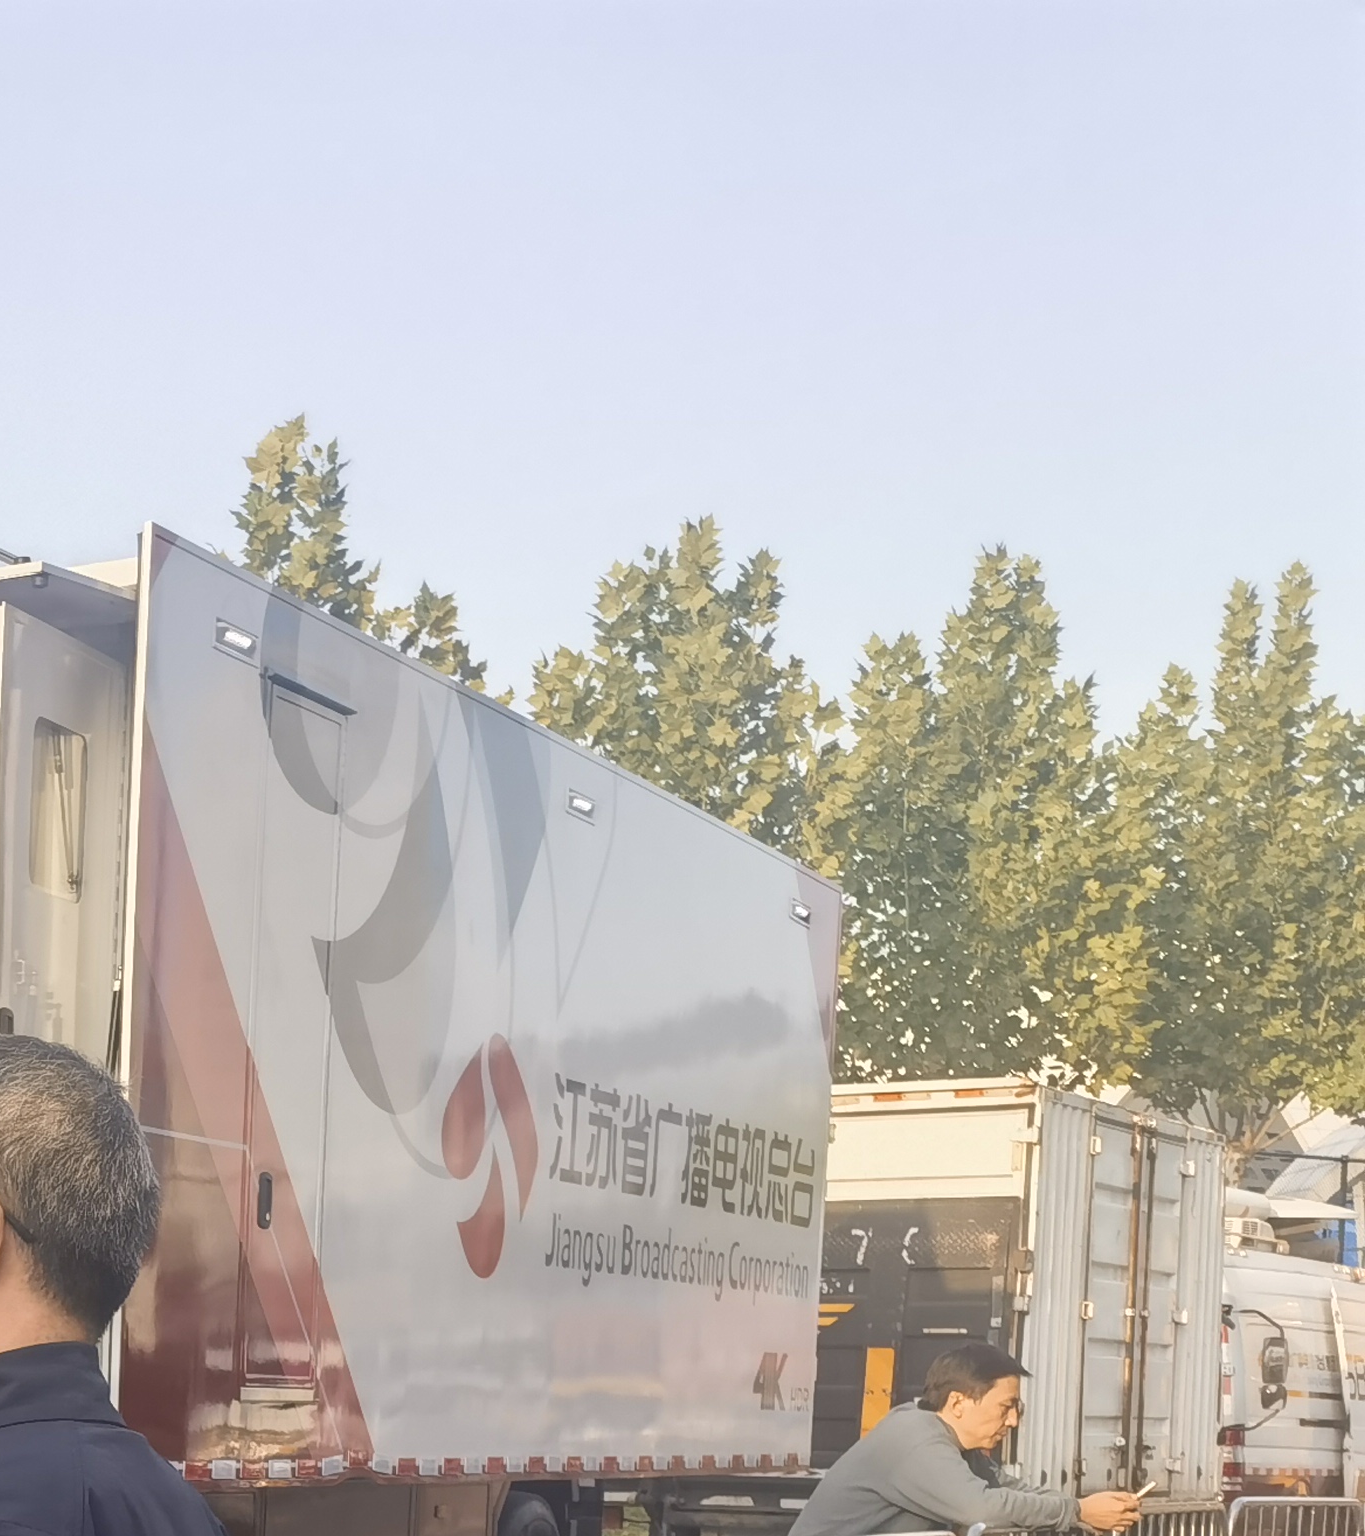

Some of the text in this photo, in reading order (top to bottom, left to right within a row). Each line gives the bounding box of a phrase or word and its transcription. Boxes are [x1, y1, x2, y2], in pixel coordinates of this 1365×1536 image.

[549, 1072, 815, 1228] 江苏省广播电视总台
[545, 1212, 809, 1306] Jiangsu Broadcasting Corporation
[752, 1352, 788, 1411] 4K
